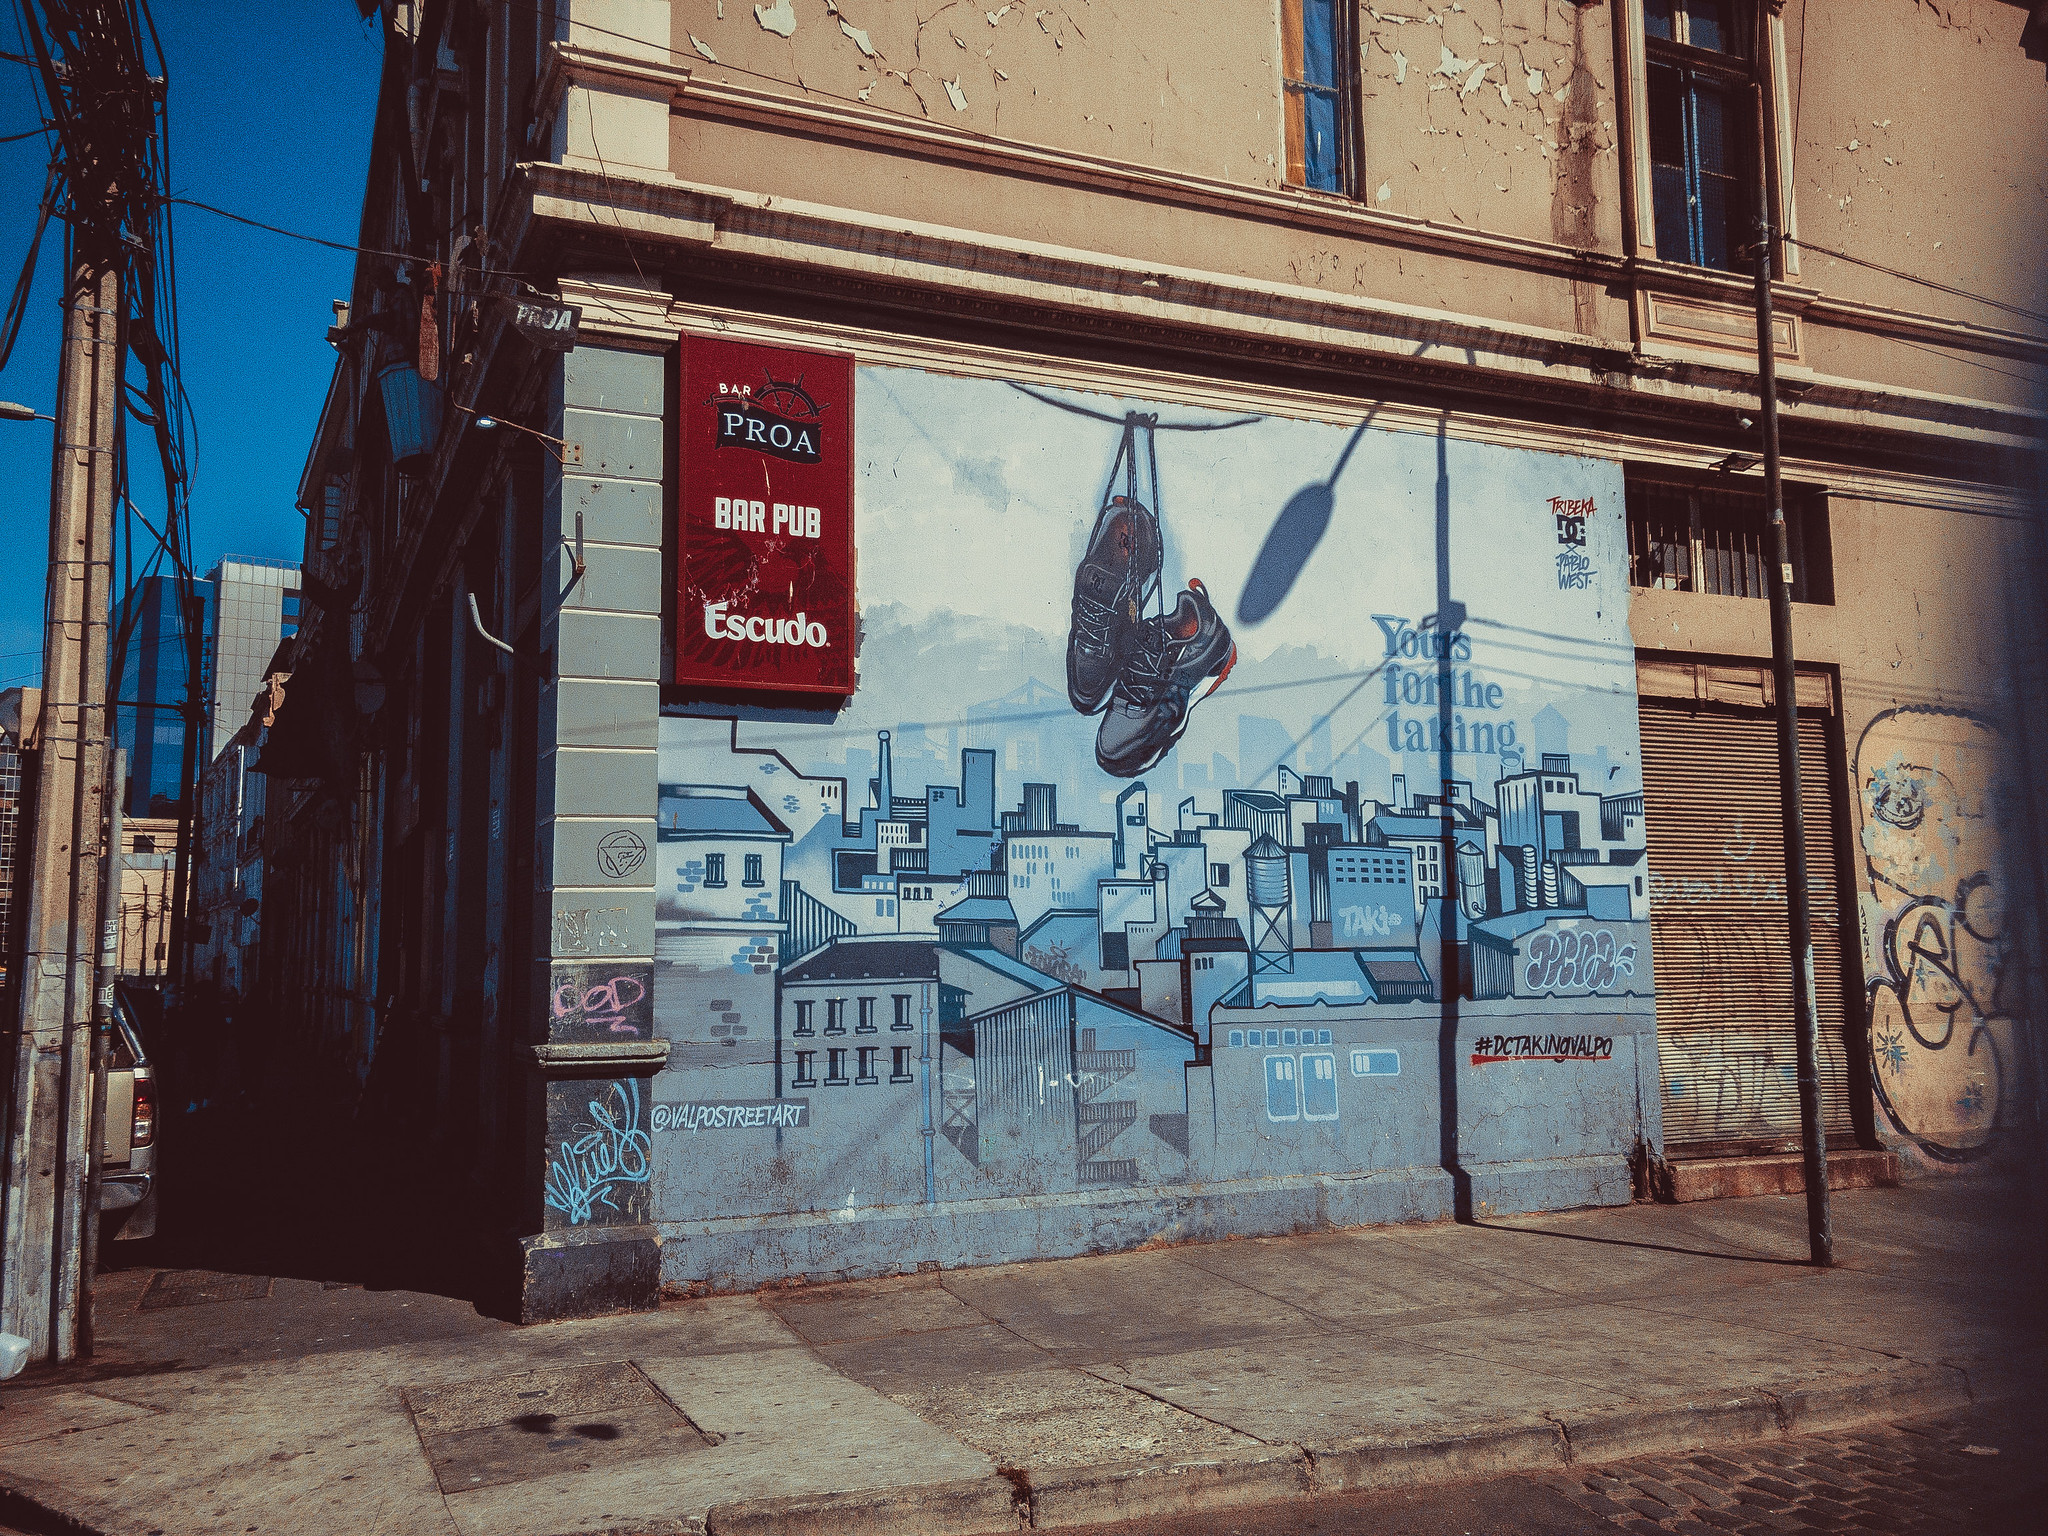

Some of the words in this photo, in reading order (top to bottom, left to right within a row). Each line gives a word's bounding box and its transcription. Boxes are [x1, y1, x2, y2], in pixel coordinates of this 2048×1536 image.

[515, 303, 572, 331] PROA
[719, 383, 751, 396] BAR
[723, 412, 816, 455] PROA
[715, 497, 765, 533] BAR
[773, 503, 821, 539] PUB
[1546, 496, 1598, 518] TRIBEKA
[704, 601, 828, 648] Escudo
[1371, 614, 1472, 661] Yours
[1383, 662, 1447, 707] for
[1446, 668, 1505, 710] the
[651, 1103, 806, 1135] @VALPOSTREETART
